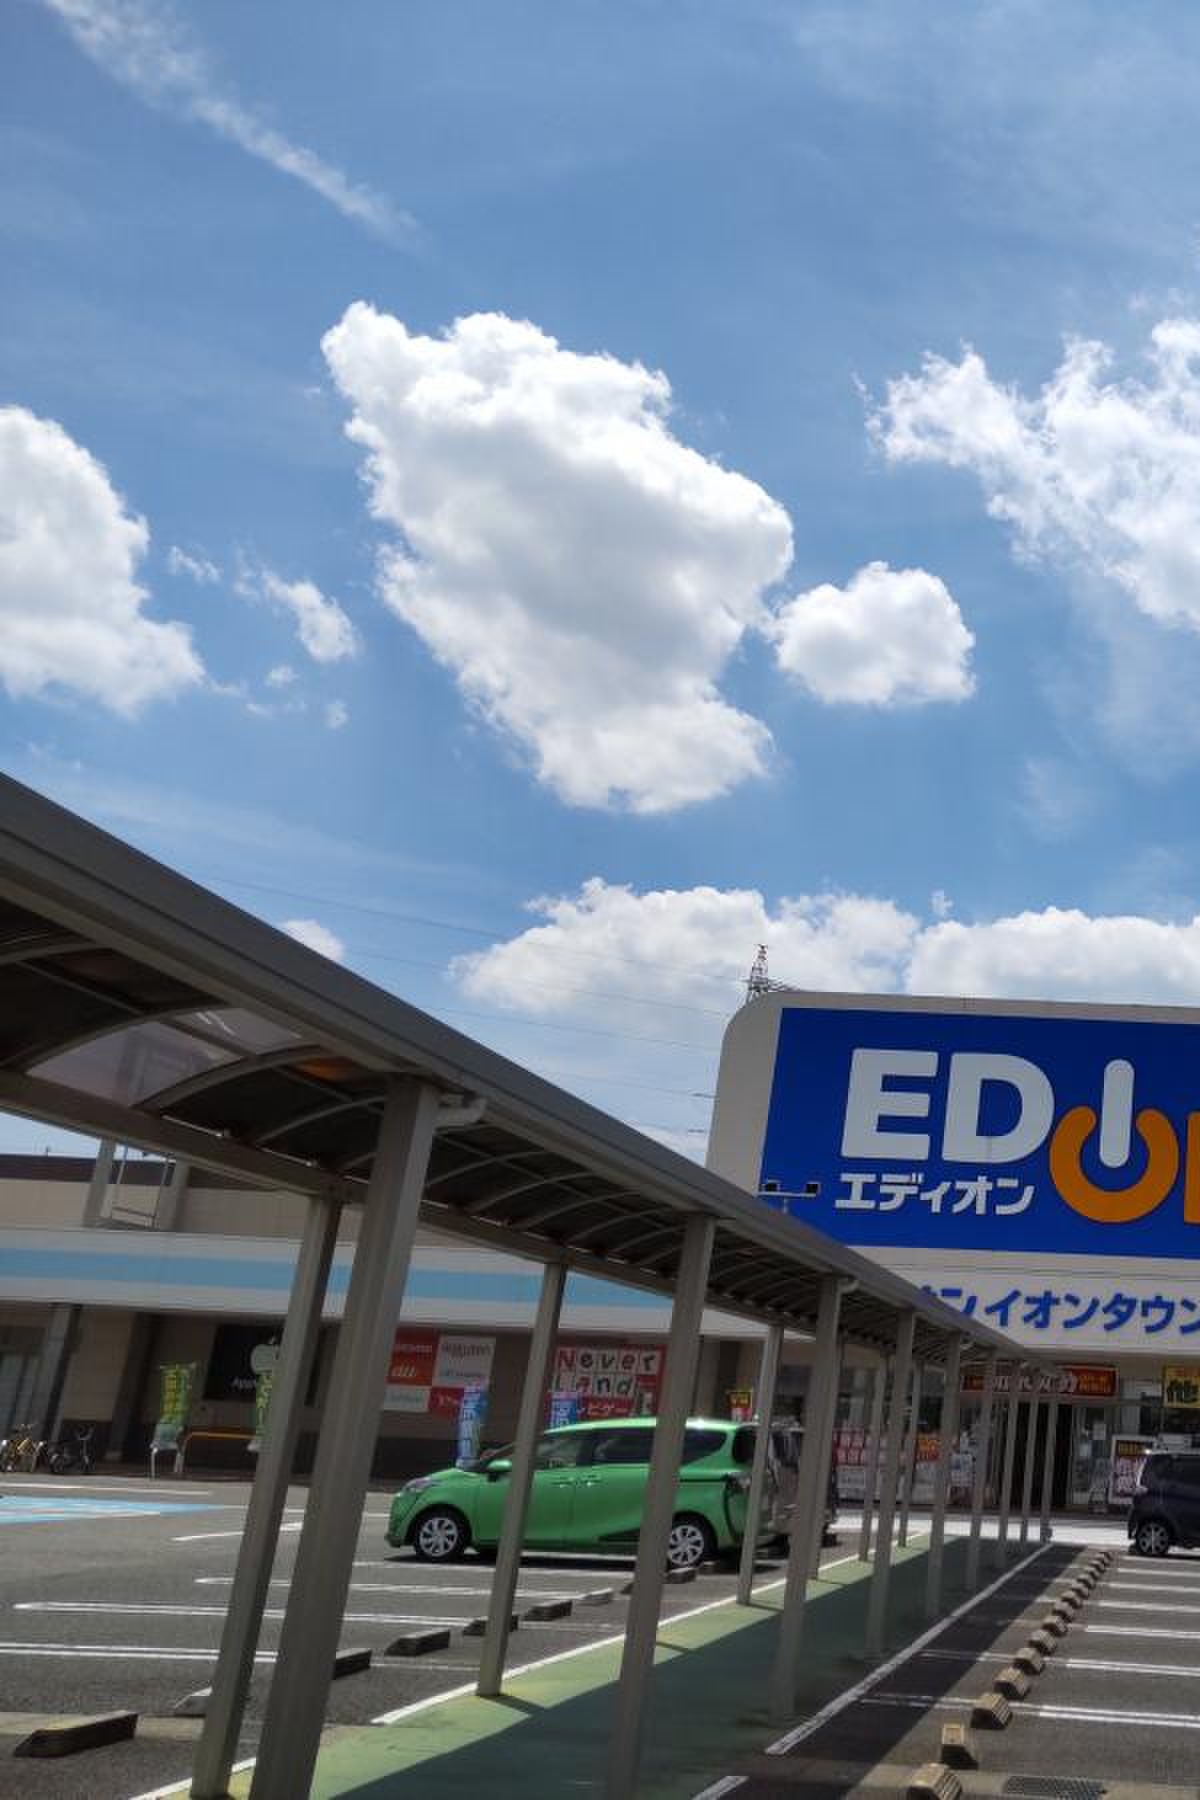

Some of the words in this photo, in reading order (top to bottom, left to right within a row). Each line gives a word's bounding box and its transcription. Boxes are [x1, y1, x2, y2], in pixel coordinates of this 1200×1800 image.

[834, 1171, 1035, 1216] エディオン
[558, 1348, 655, 1372] Never
